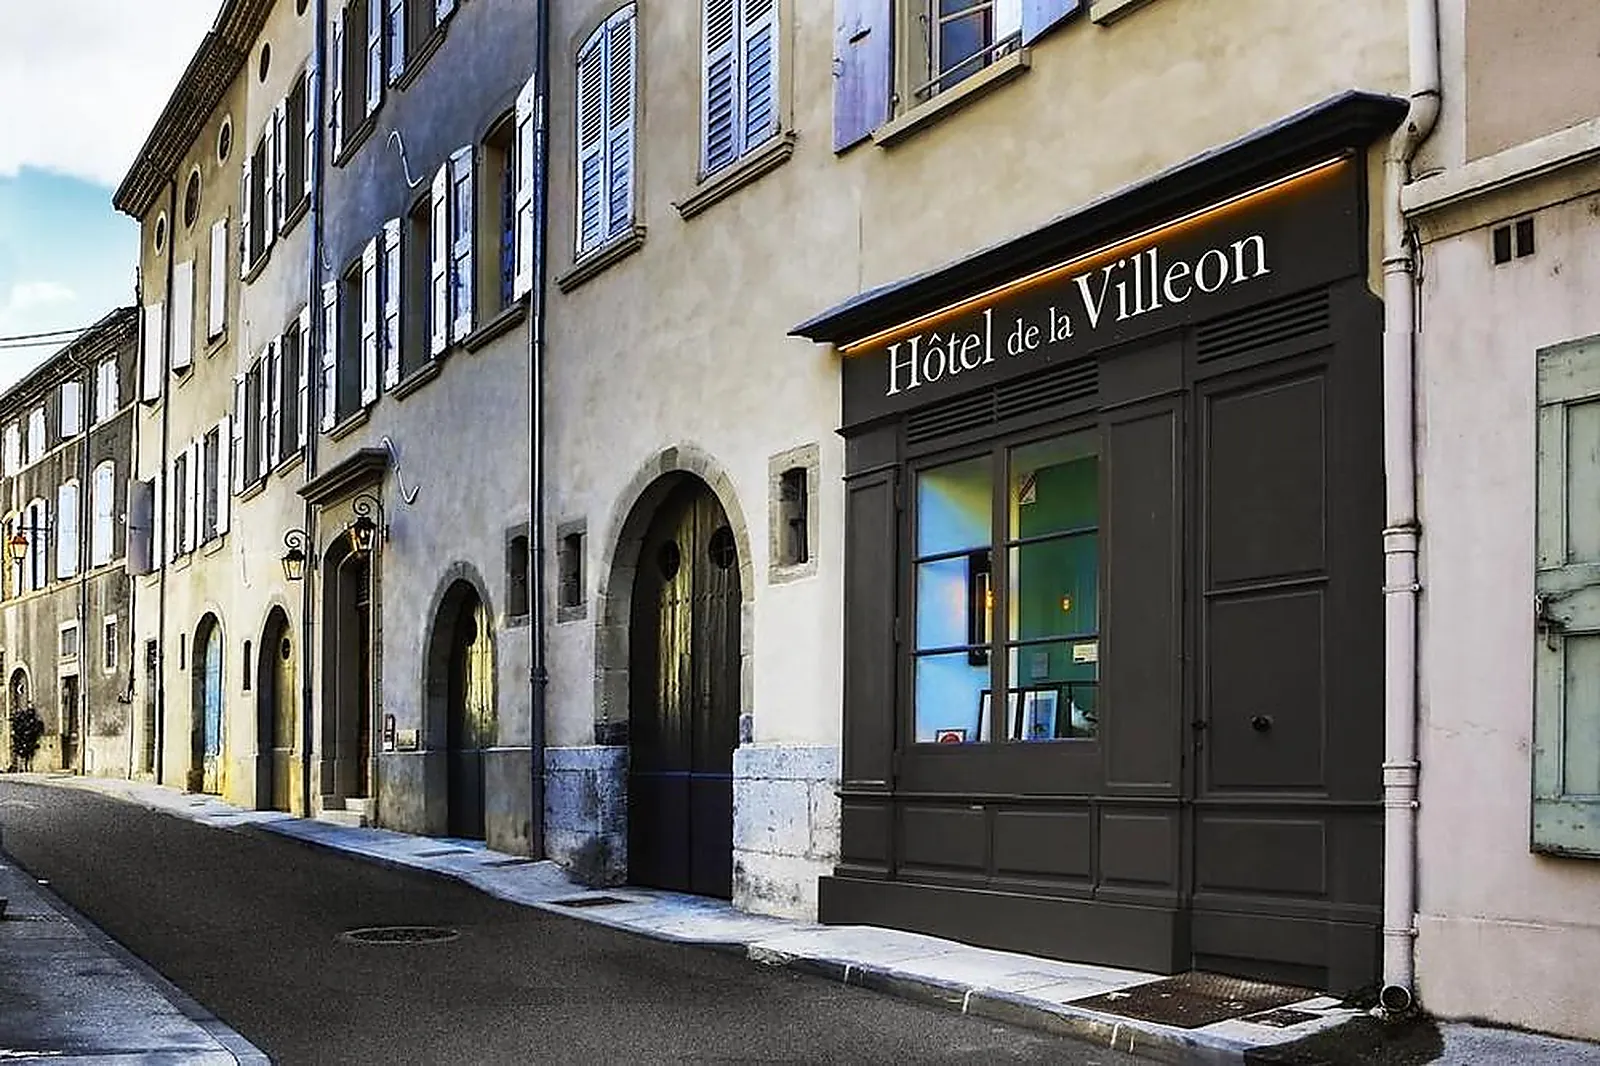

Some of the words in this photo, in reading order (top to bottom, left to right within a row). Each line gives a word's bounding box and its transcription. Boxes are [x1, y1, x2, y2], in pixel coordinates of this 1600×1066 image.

[885, 309, 995, 397] Hôtel
[1007, 318, 1040, 356] de
[1048, 307, 1073, 343] la
[1073, 233, 1270, 330] Villeon
